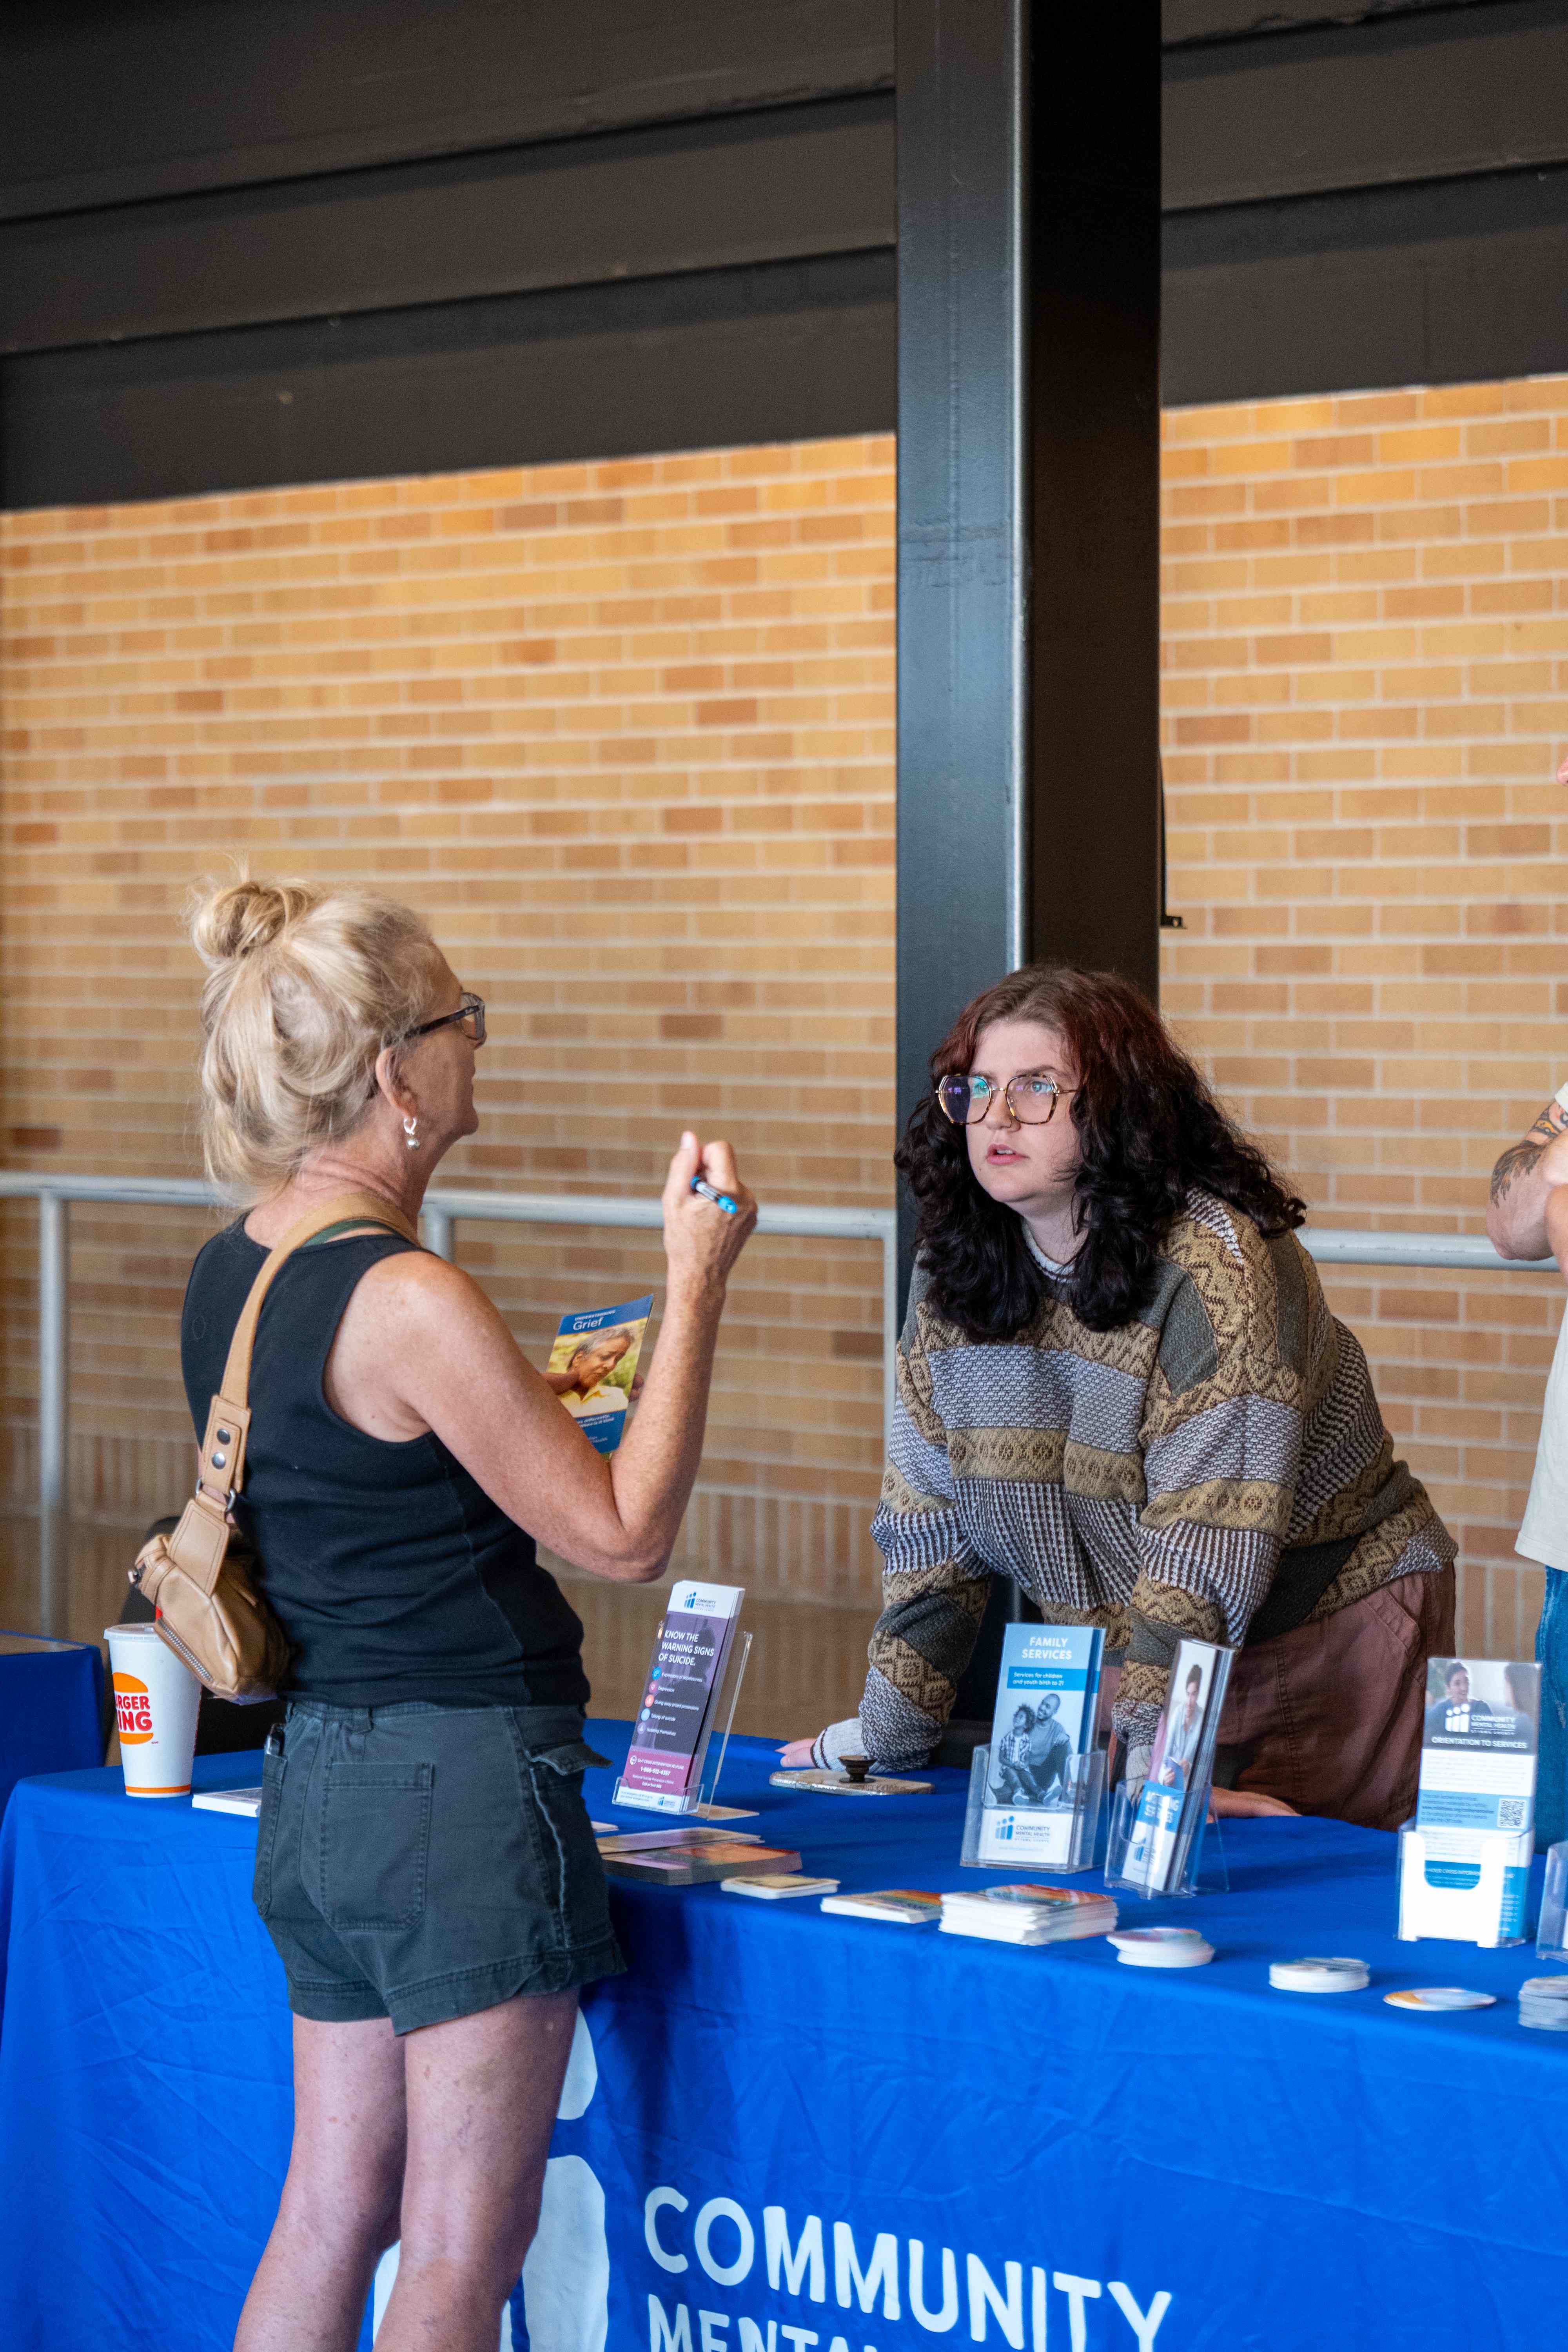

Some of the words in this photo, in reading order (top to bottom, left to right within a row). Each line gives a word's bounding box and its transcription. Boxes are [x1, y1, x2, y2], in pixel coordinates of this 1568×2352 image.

[573, 1317, 604, 1330] Grief
[664, 1630, 685, 1640] KNOW
[686, 1633, 699, 1642] THE
[1029, 1637, 1068, 1647] FAMILY
[662, 1642, 693, 1653] WARNING
[693, 1646, 714, 1657] SIGNS
[1022, 1648, 1072, 1660] SERVICES
[658, 1653, 668, 1661] OF
[668, 1654, 695, 1666] SUICIDE.
[116, 1695, 150, 1710] RGER
[118, 1710, 152, 1731] ING
[1471, 1715, 1516, 1723] COMMUNITY
[1431, 1737, 1480, 1746] ORIENTATION
[1492, 1740, 1528, 1749] SERVICES
[644, 2186, 1172, 2352] COMMUNITY
[648, 2294, 878, 2352] MEN
